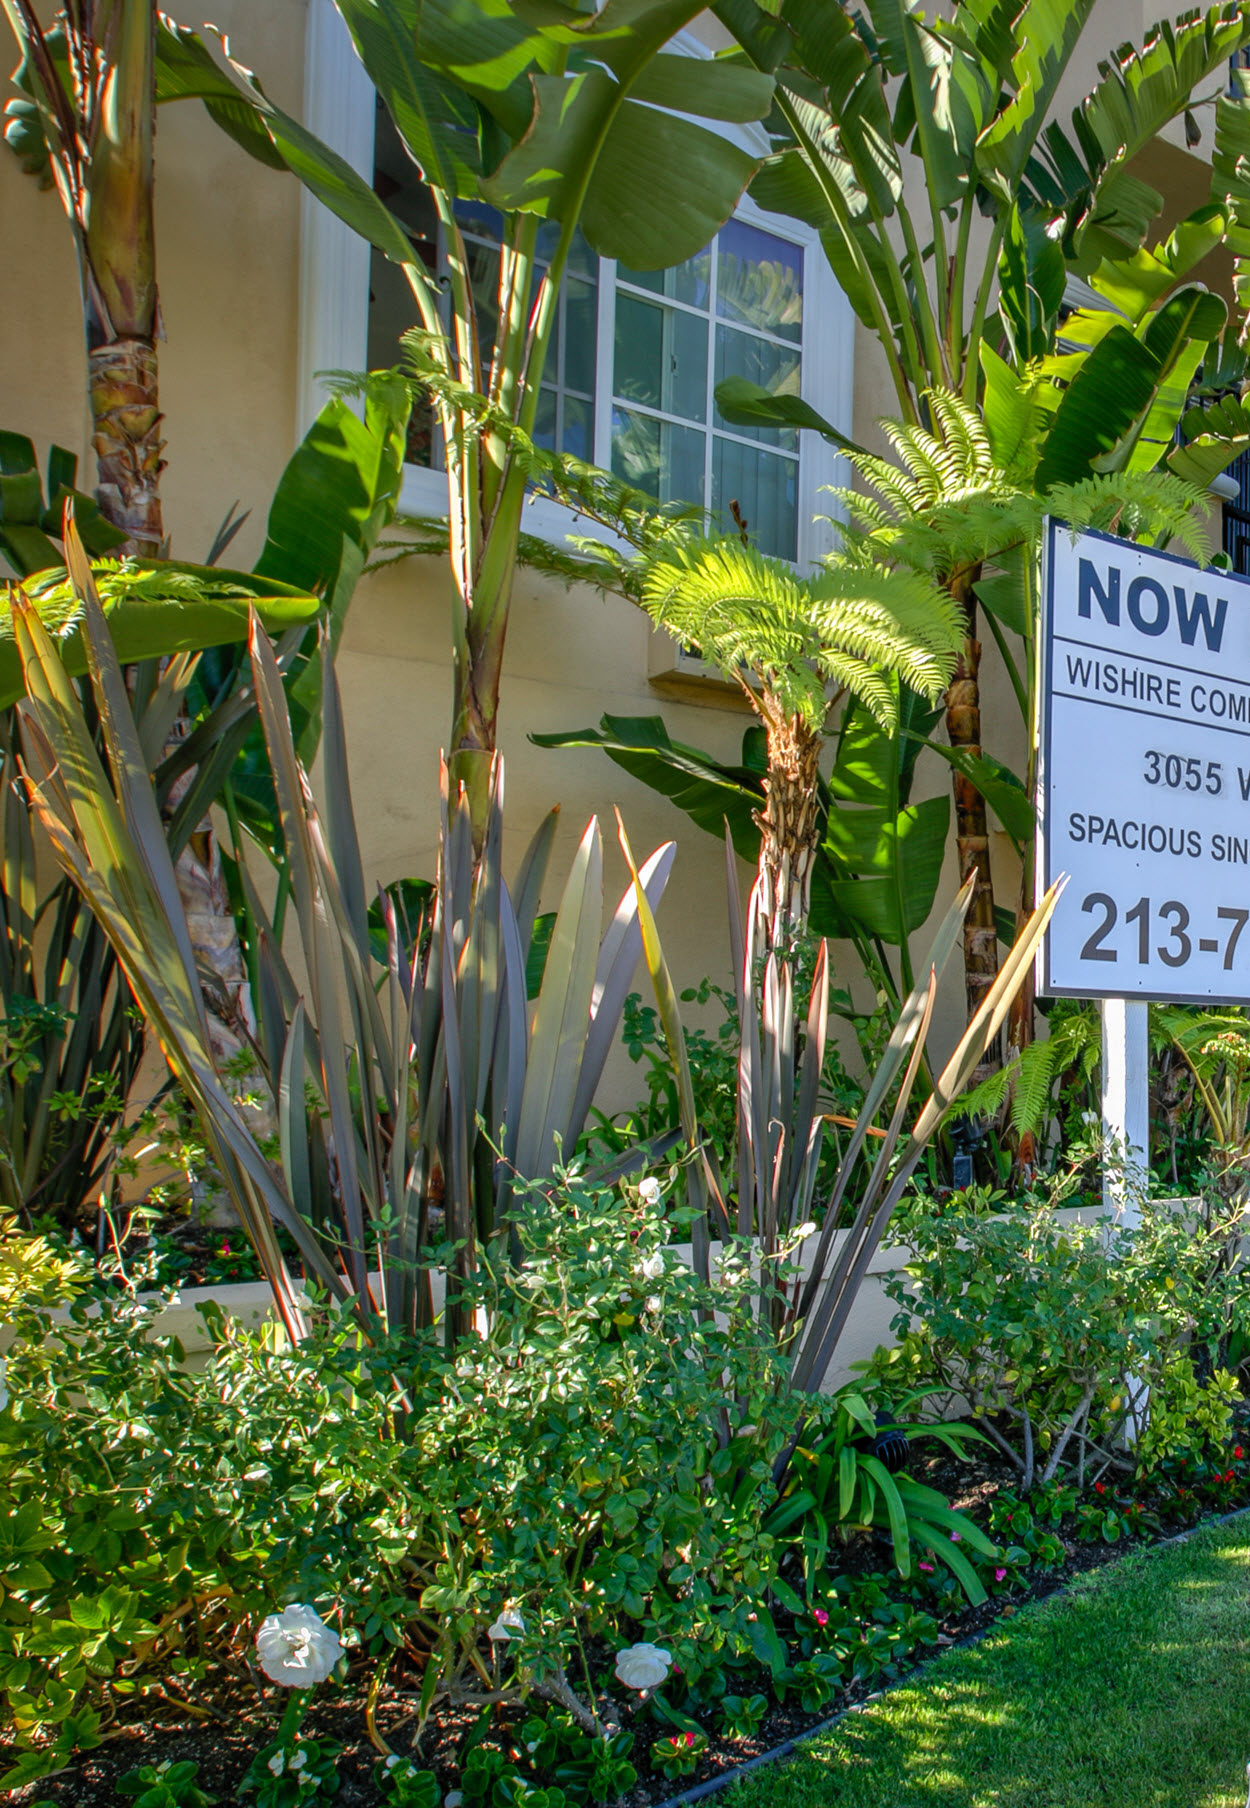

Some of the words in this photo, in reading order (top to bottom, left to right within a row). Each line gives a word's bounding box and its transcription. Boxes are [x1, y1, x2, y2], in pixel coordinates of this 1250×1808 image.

[1078, 558, 1228, 653] NOW
[1067, 655, 1181, 708] WISHIRE
[1144, 751, 1221, 795] 3055
[1069, 813, 1201, 857] SPACIOUS
